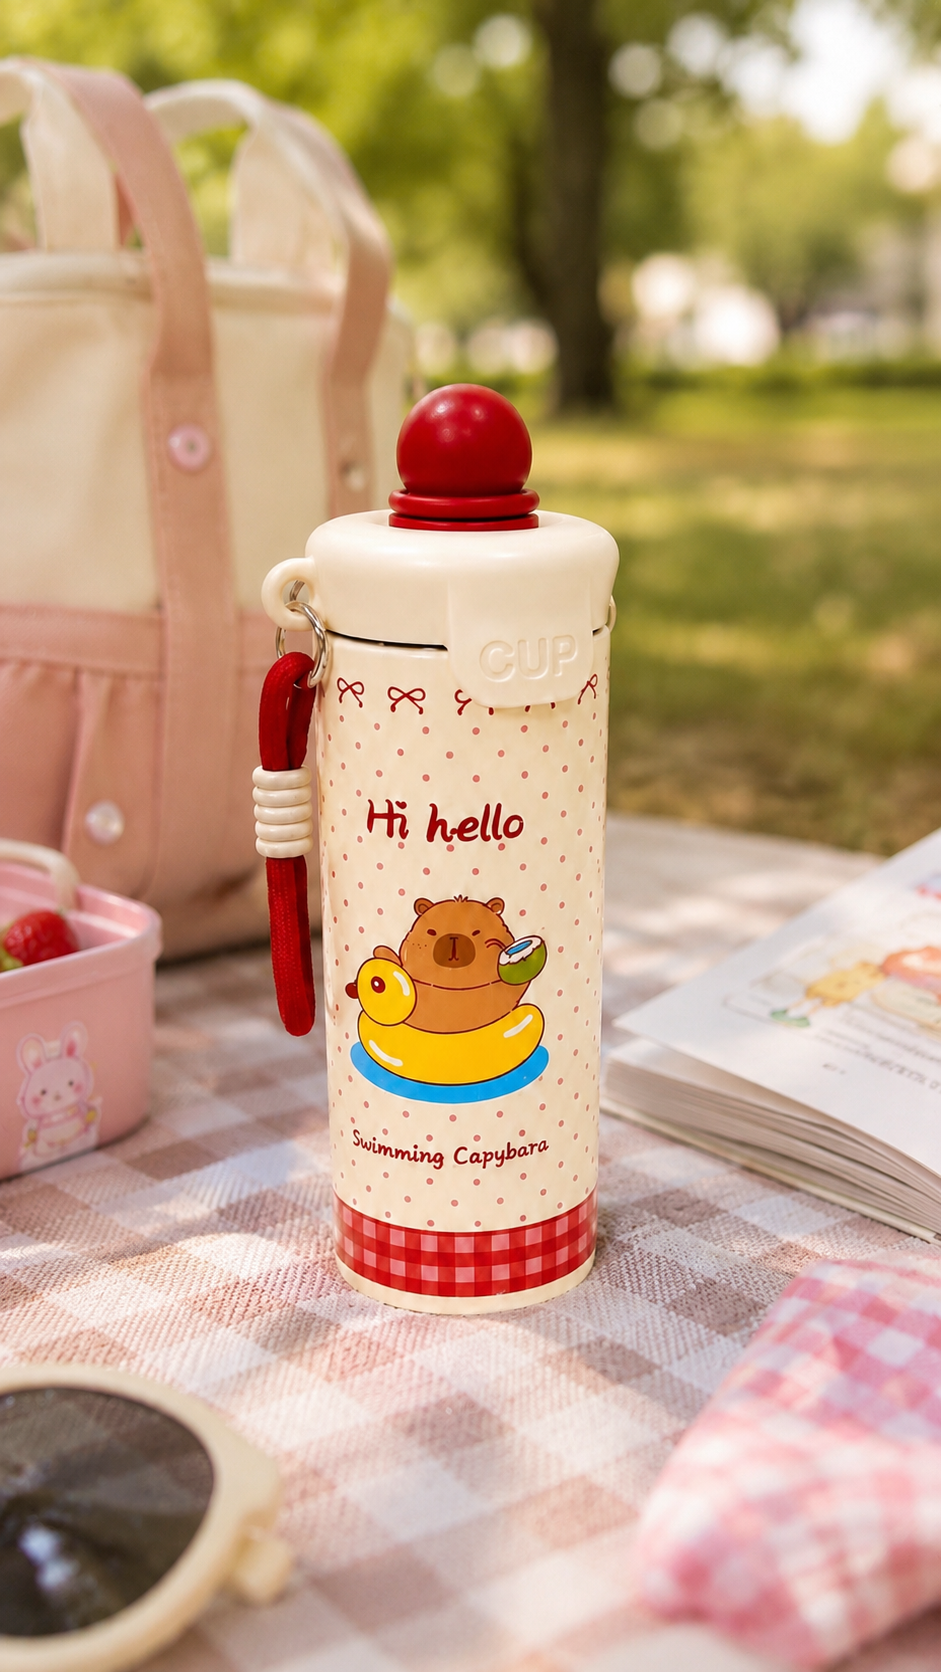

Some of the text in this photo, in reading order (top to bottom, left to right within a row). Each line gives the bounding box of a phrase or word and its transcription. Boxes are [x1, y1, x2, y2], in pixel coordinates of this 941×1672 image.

[479, 634, 578, 682] CUP
[367, 799, 524, 842] Hi hello
[353, 1129, 549, 1169] Swimming Capybara
